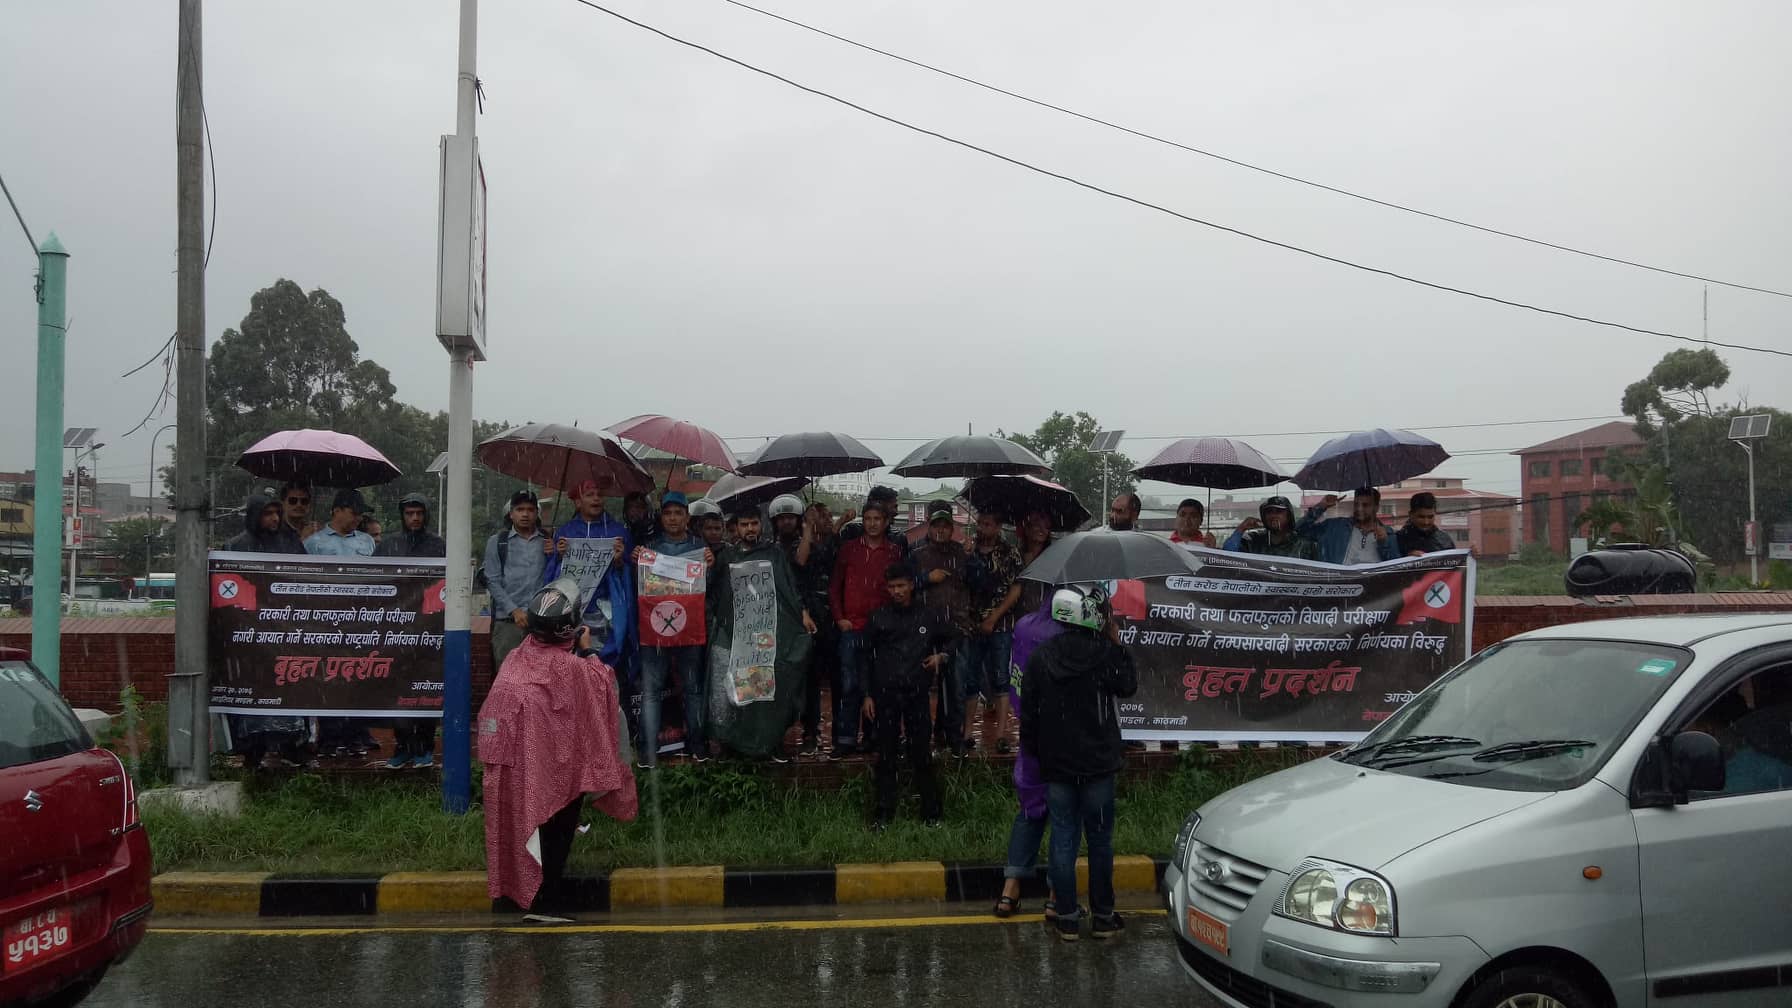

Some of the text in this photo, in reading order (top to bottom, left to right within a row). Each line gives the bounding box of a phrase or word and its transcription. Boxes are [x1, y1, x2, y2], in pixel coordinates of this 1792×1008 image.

[734, 571, 771, 592] STOP
[259, 605, 416, 626] तरकारी तथा फलफुलको विषादी परीक्षण
[1149, 603, 1391, 630] तरकारी तथा फलफुलको विषादी परीक्षण
[256, 631, 286, 644] आयात
[286, 628, 304, 645] गर्ने
[303, 630, 345, 646] सरकारको
[384, 630, 420, 647] निर्णयका
[1140, 630, 1184, 647] आयात
[1186, 629, 1212, 649] गर्ने
[1213, 632, 1290, 654] लम्पसारवादी
[1294, 632, 1354, 652] सरकारको
[1357, 631, 1409, 650] निर्णयका
[274, 650, 394, 687] बृहत प्रदर्शन
[1183, 659, 1361, 701] बृहत प्रदर्शन
[1120, 703, 1144, 713] २०७६
[9, 926, 68, 962] ५१३७
